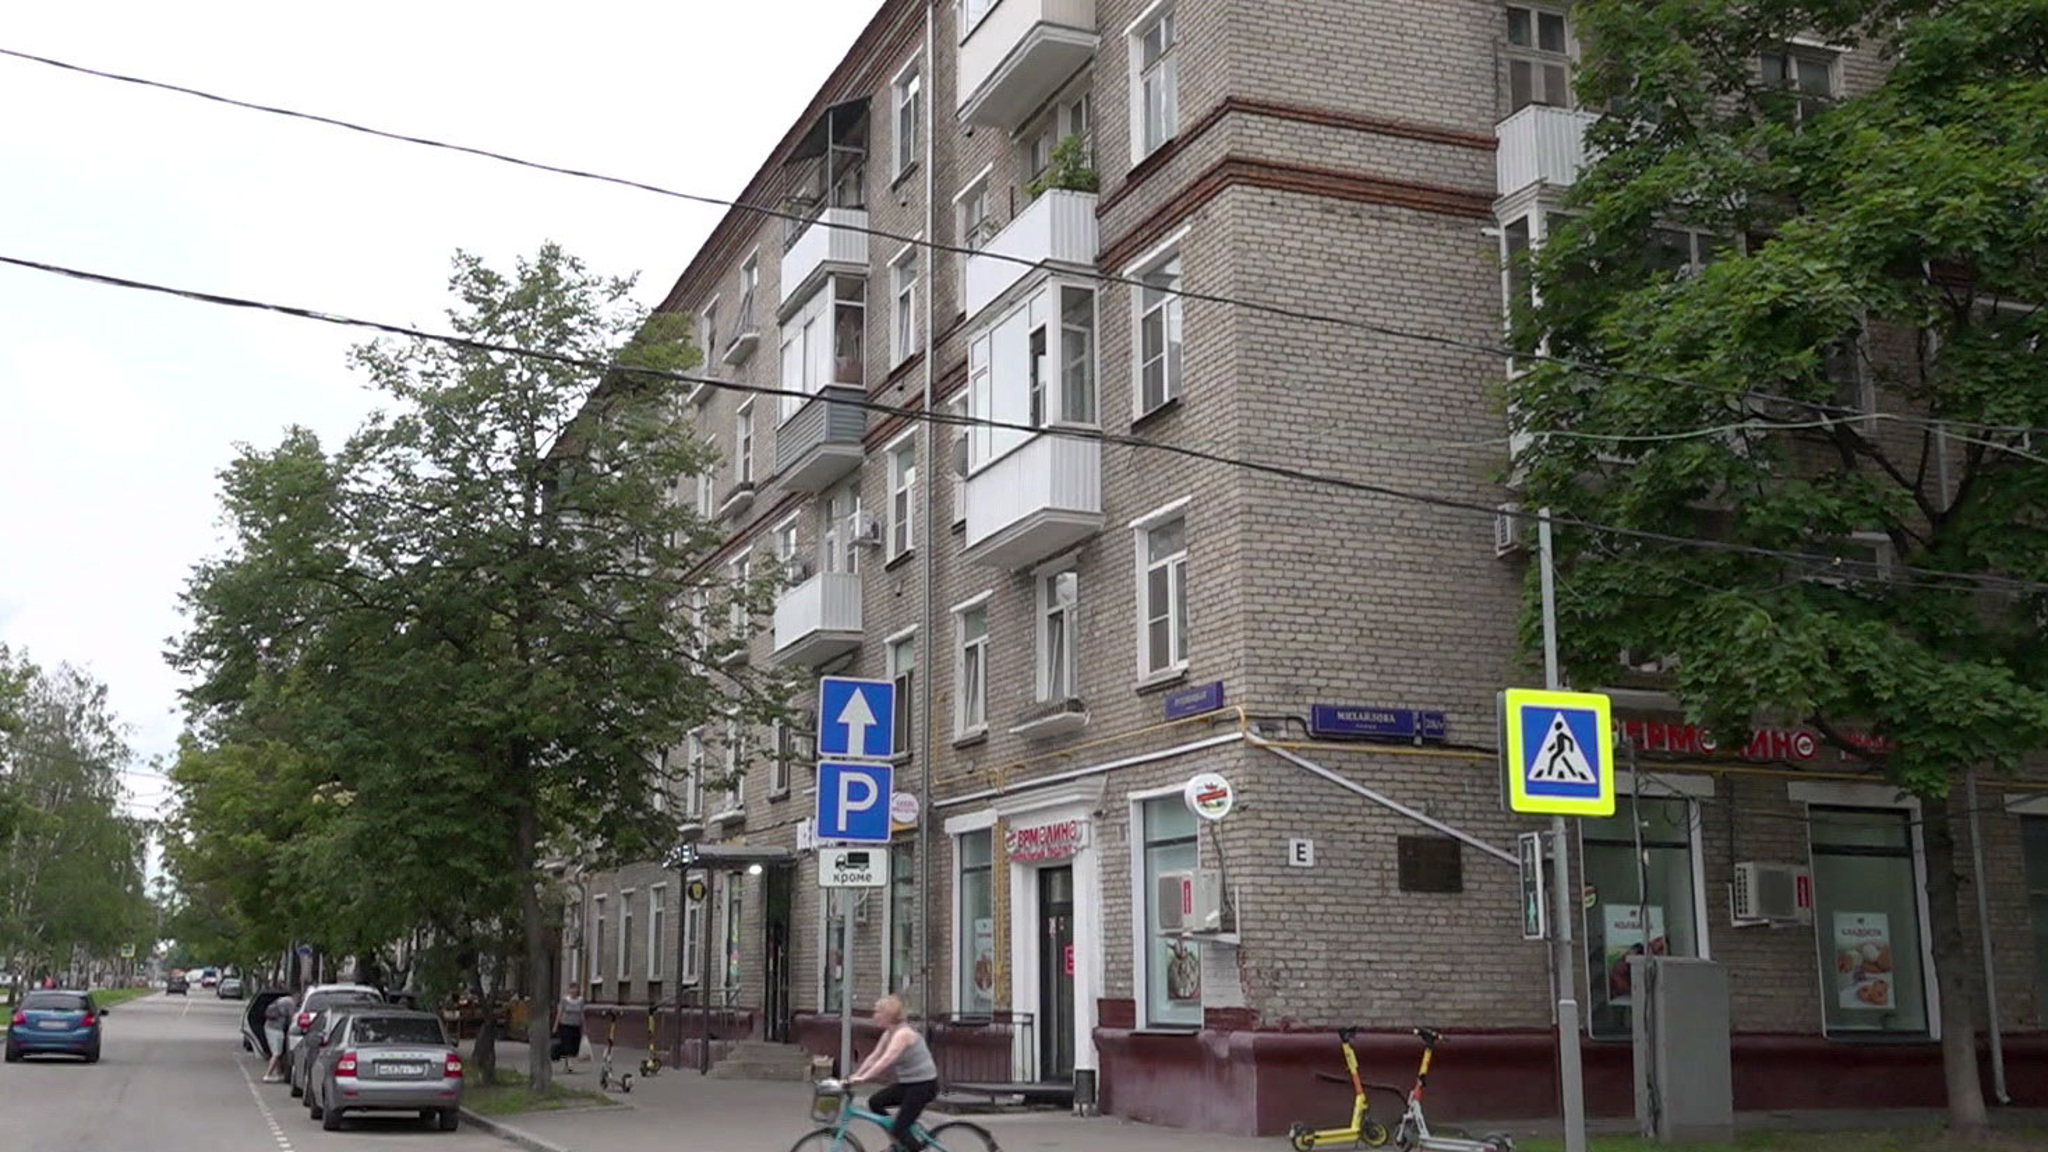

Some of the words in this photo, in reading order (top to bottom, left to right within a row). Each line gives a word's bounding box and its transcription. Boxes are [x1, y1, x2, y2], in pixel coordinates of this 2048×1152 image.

[1336, 711, 1396, 724] МИХАЙЛОВА
[1624, 721, 1819, 760] ЕРМОИНО
[837, 771, 878, 831] P
[1018, 821, 1077, 848] ЕРМОЛИНО
[833, 873, 872, 884] кроме
